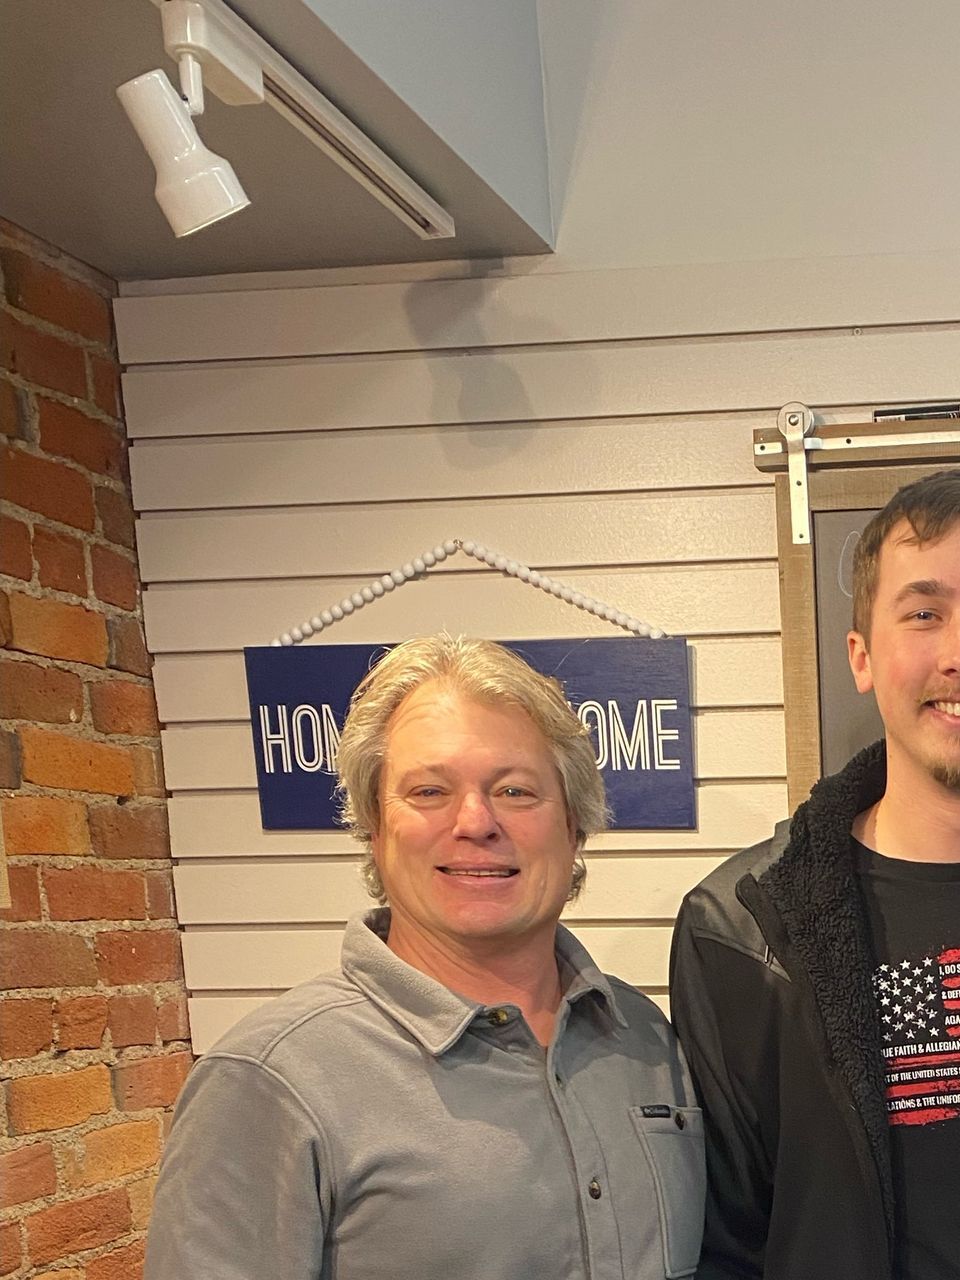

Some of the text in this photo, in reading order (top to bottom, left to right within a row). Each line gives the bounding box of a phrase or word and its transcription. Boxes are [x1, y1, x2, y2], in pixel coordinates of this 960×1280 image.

[568, 699, 681, 771] OME
[945, 964, 956, 974] DO
[941, 991, 948, 1000] &
[881, 1047, 894, 1058] UE
[894, 1044, 917, 1057] FAITH
[917, 1043, 924, 1053] &
[891, 1073, 899, 1082] OF
[900, 1072, 912, 1081] THE
[912, 1069, 935, 1079] UNITED
[936, 1067, 958, 1077] STATES
[916, 1098, 922, 1107] &
[922, 1096, 936, 1106] THE
